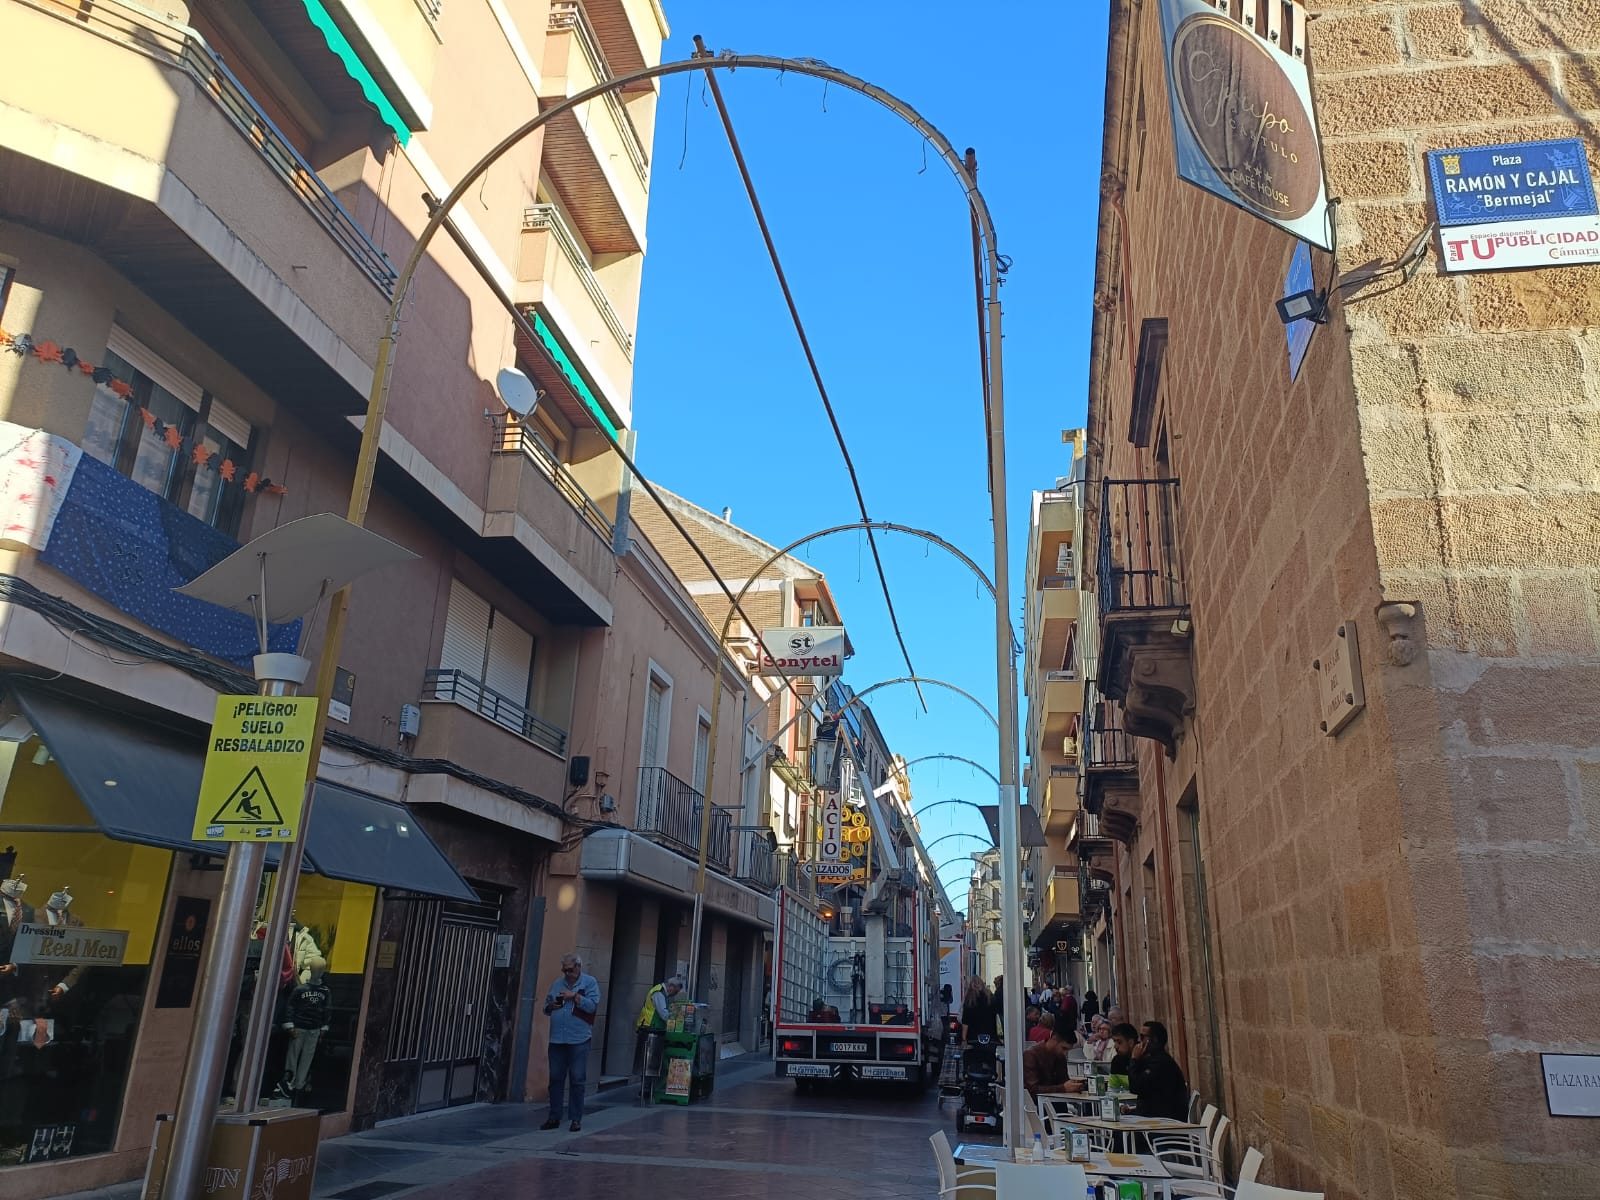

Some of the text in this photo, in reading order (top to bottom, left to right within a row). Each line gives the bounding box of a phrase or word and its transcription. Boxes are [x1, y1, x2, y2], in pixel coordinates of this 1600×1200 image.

[1492, 155, 1522, 167] Plaza
[1231, 168, 1290, 207] CAFÉ HOUSE
[1445, 169, 1580, 194] RAMÓN Y CAJAL
[1470, 229, 1537, 240] Espacio disponible
[1447, 230, 1599, 262] Para TU PUBLICIDAD
[1548, 246, 1599, 259] Cámara
[790, 636, 811, 649] st
[763, 654, 838, 670] Sonytel
[233, 702, 297, 718] ¡PELIGRO!
[241, 720, 284, 734] SUELO
[214, 738, 305, 753] RESBALADIZO
[20, 925, 66, 939] Dressing
[39, 936, 119, 959] Real Men
[1549, 1073, 1582, 1087] PLAZA
